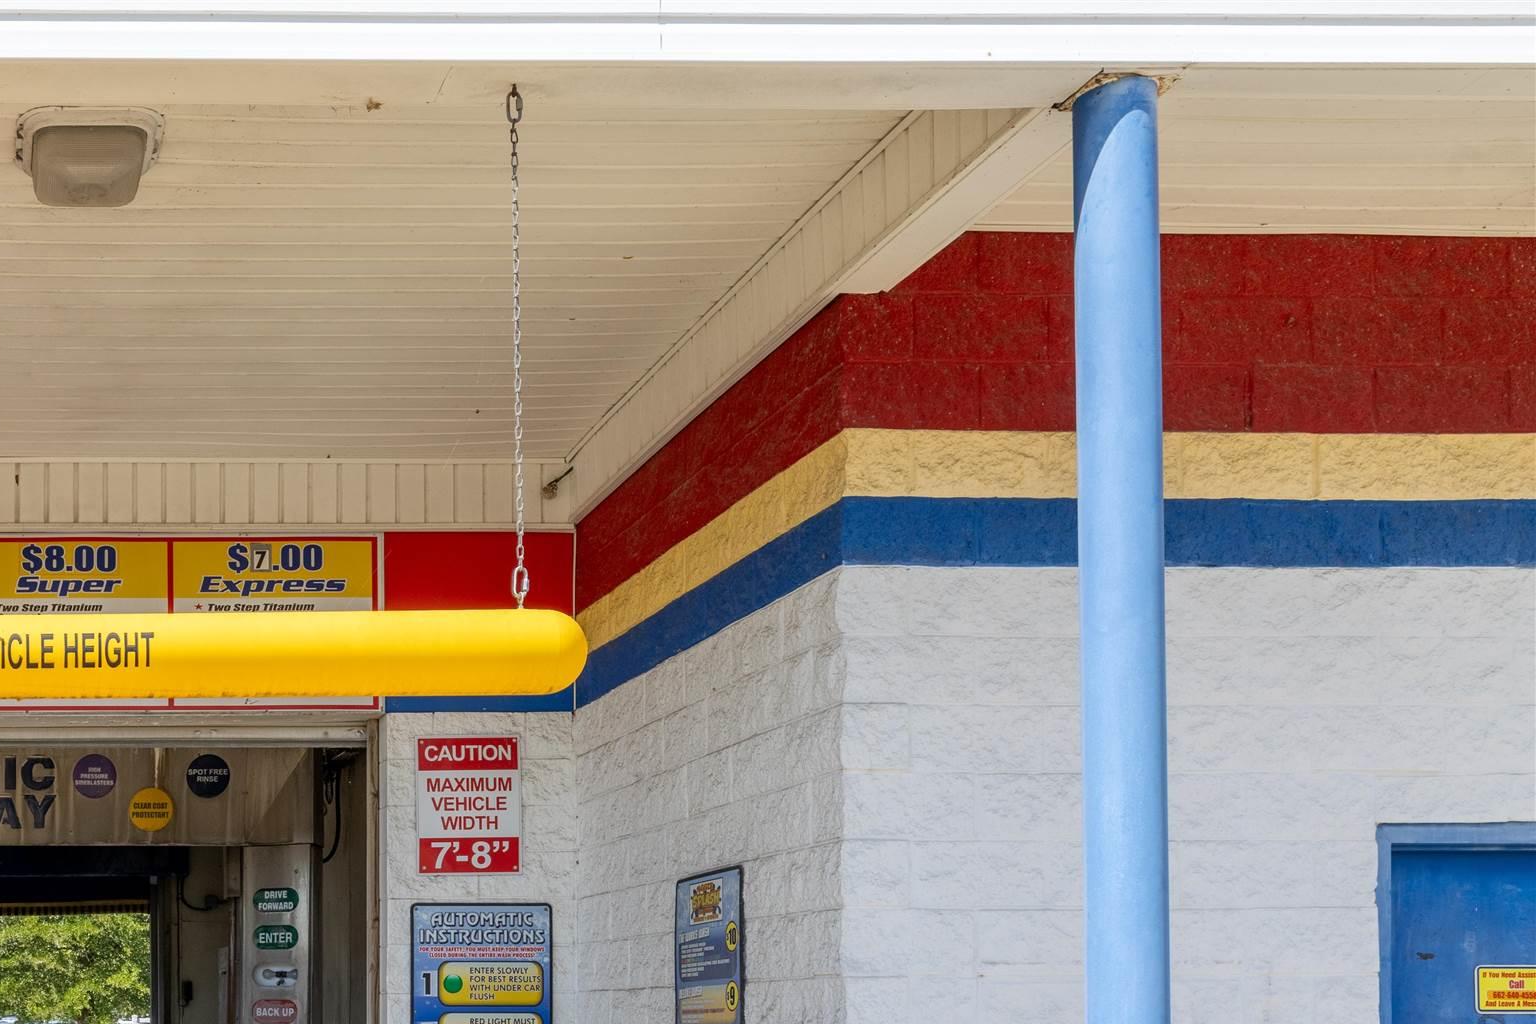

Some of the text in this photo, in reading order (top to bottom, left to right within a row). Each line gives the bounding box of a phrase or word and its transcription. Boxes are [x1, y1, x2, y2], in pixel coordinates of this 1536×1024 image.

[22, 543, 117, 574] $8.00
[228, 543, 323, 573] $7.00
[16, 576, 122, 597] Super
[200, 576, 346, 597] Express
[21, 604, 48, 613] Step
[51, 603, 103, 612] Titanium
[207, 603, 315, 613] Two Step Titanium
[64, 631, 155, 669] HEIGHT
[424, 744, 512, 762] CAUTION
[188, 768, 207, 776] SPOT
[426, 777, 512, 792] MAXIMUM
[432, 796, 507, 811] VEHICLE
[441, 815, 498, 830] WIDTH
[264, 890, 288, 899] DRIVE
[258, 901, 294, 910] FORWARD
[431, 912, 534, 927] AUTOMATIC
[259, 932, 293, 944] ENTER
[419, 929, 545, 945] INSTRUCTIONS
[422, 973, 431, 995] 1
[1509, 980, 1524, 989] Call
[256, 1007, 295, 1017] BACK UP
